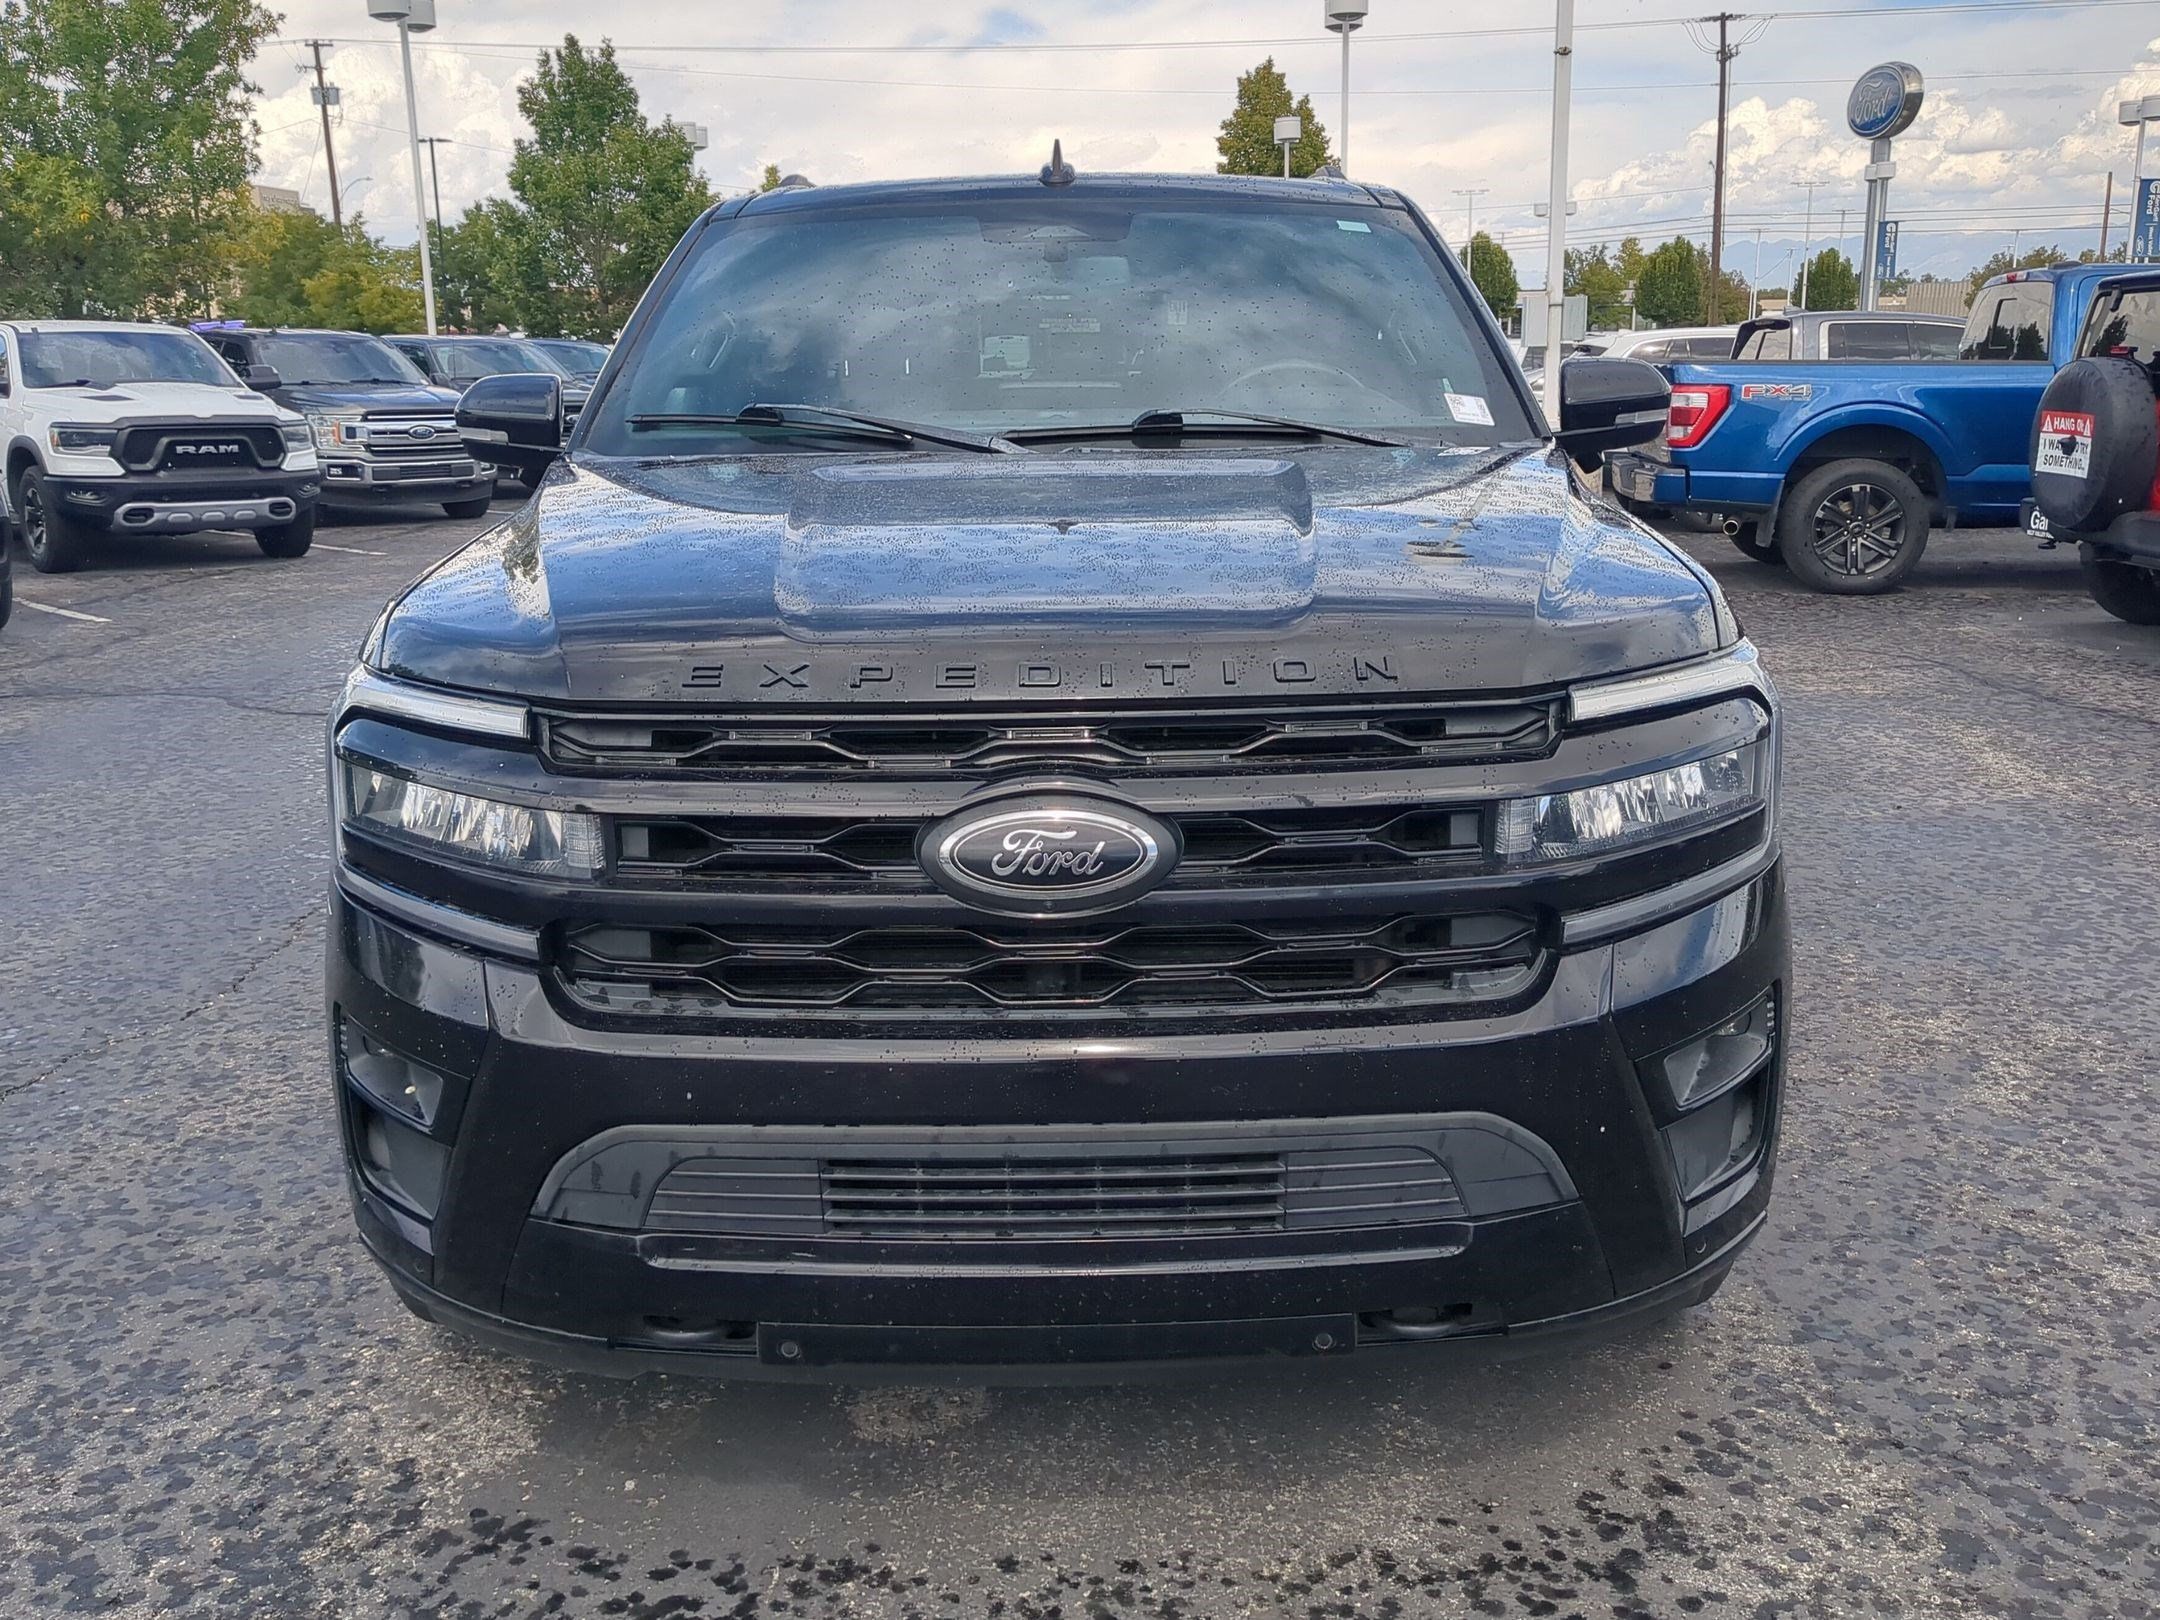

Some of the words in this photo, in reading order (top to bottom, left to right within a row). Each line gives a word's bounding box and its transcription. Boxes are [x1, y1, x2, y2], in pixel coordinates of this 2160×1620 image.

[1854, 80, 1892, 124] Ford
[2146, 195, 2155, 214] Ford
[1742, 384, 1811, 400] FX4
[2053, 417, 2075, 431] HANG
[176, 445, 239, 454] RAM
[682, 656, 1398, 688] EXPEDITION
[991, 828, 1106, 876] Ford
